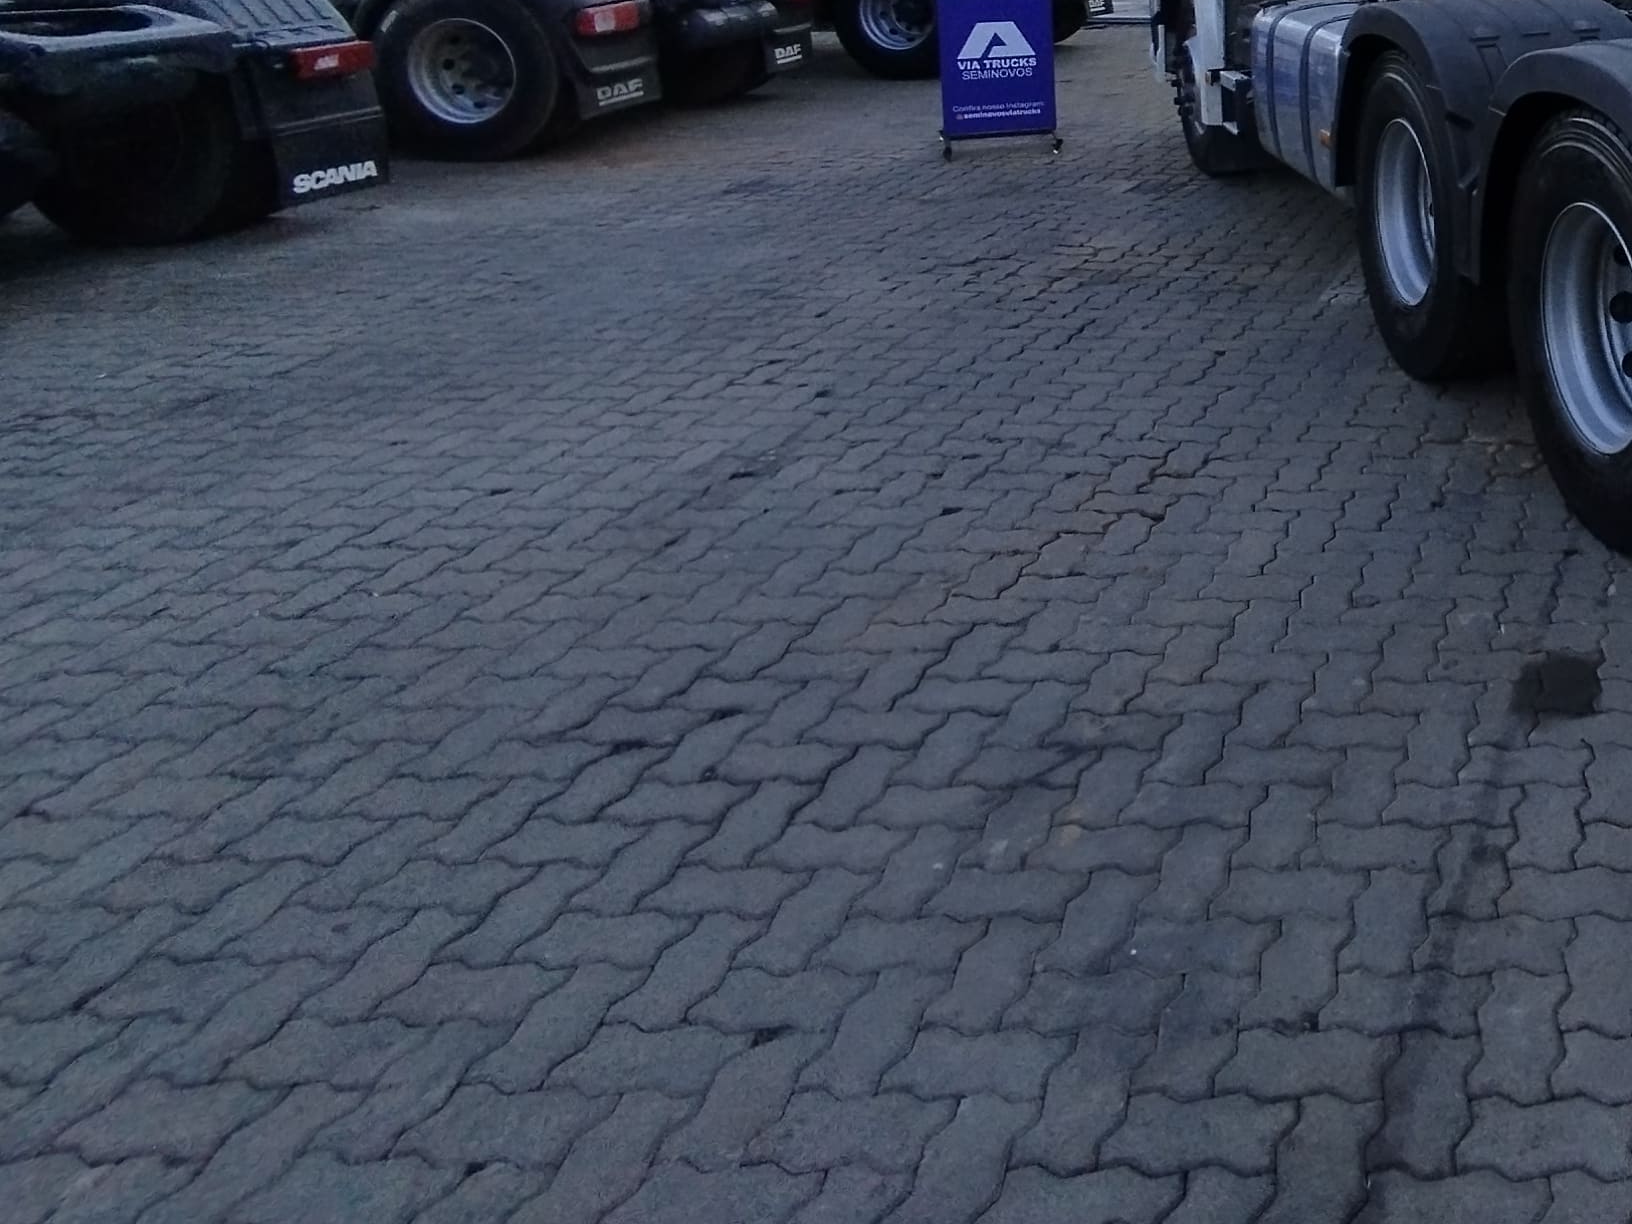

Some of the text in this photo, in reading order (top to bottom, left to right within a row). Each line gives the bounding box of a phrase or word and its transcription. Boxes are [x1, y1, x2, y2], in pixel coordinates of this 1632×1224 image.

[774, 43, 802, 59] DAF
[957, 57, 1037, 70] VIA TRUCKS
[961, 67, 1033, 81] SEMINOVOS
[596, 78, 643, 100] DAF
[293, 160, 378, 194] SCANIA
